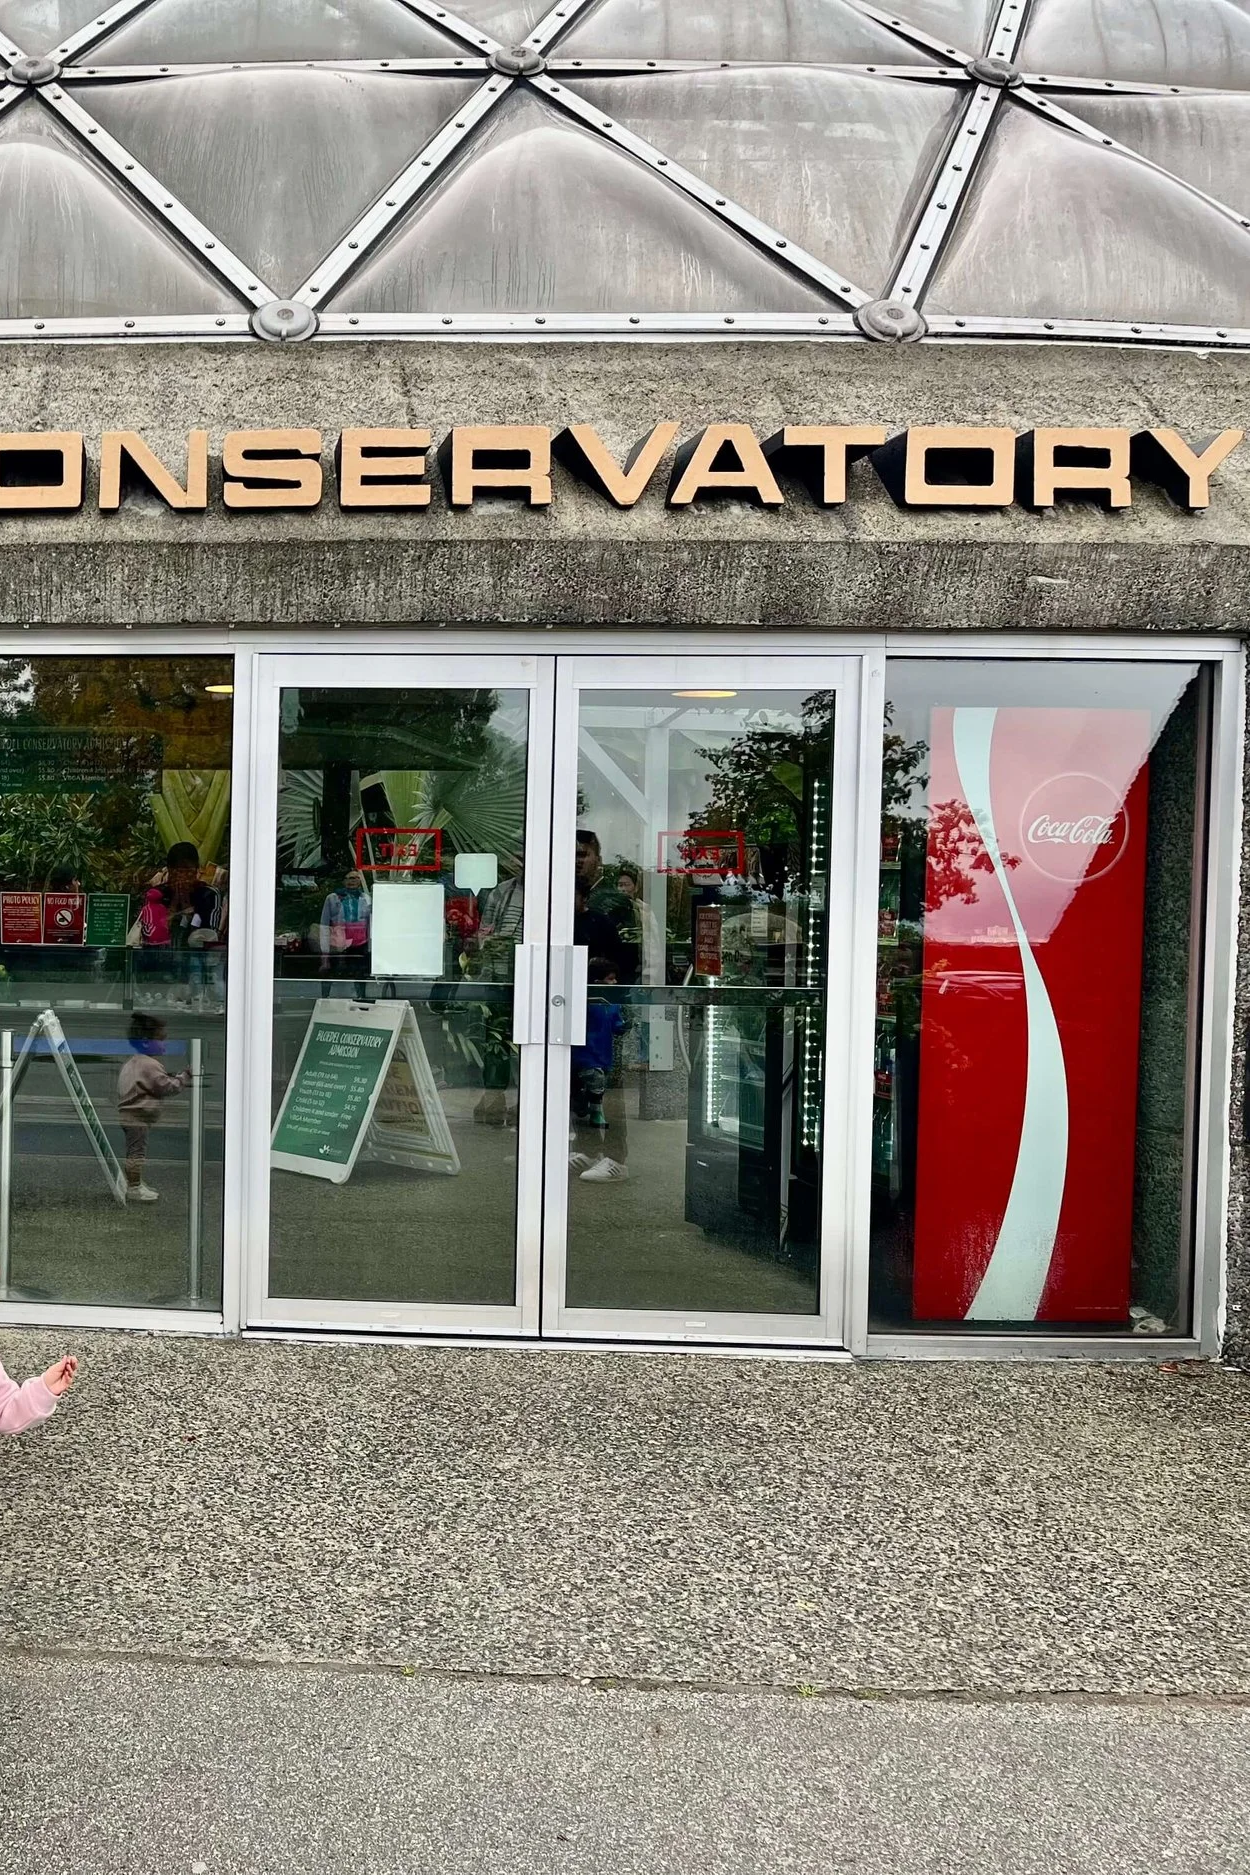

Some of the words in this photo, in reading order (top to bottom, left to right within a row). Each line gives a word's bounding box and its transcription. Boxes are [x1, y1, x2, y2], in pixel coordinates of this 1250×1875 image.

[22, 737, 83, 750] CONSERVATORY
[3, 895, 21, 904] PHOTO
[21, 895, 40, 905] POLICY
[47, 897, 54, 905] NO
[54, 897, 67, 905] FOOD
[316, 1030, 340, 1044] BLOEDEL
[339, 1032, 384, 1049] CONSERVATORY
[327, 1044, 361, 1059] ADMISSION
[304, 1070, 317, 1078] Adult
[340, 1112, 353, 1121] Free
[337, 1121, 349, 1130] Free
